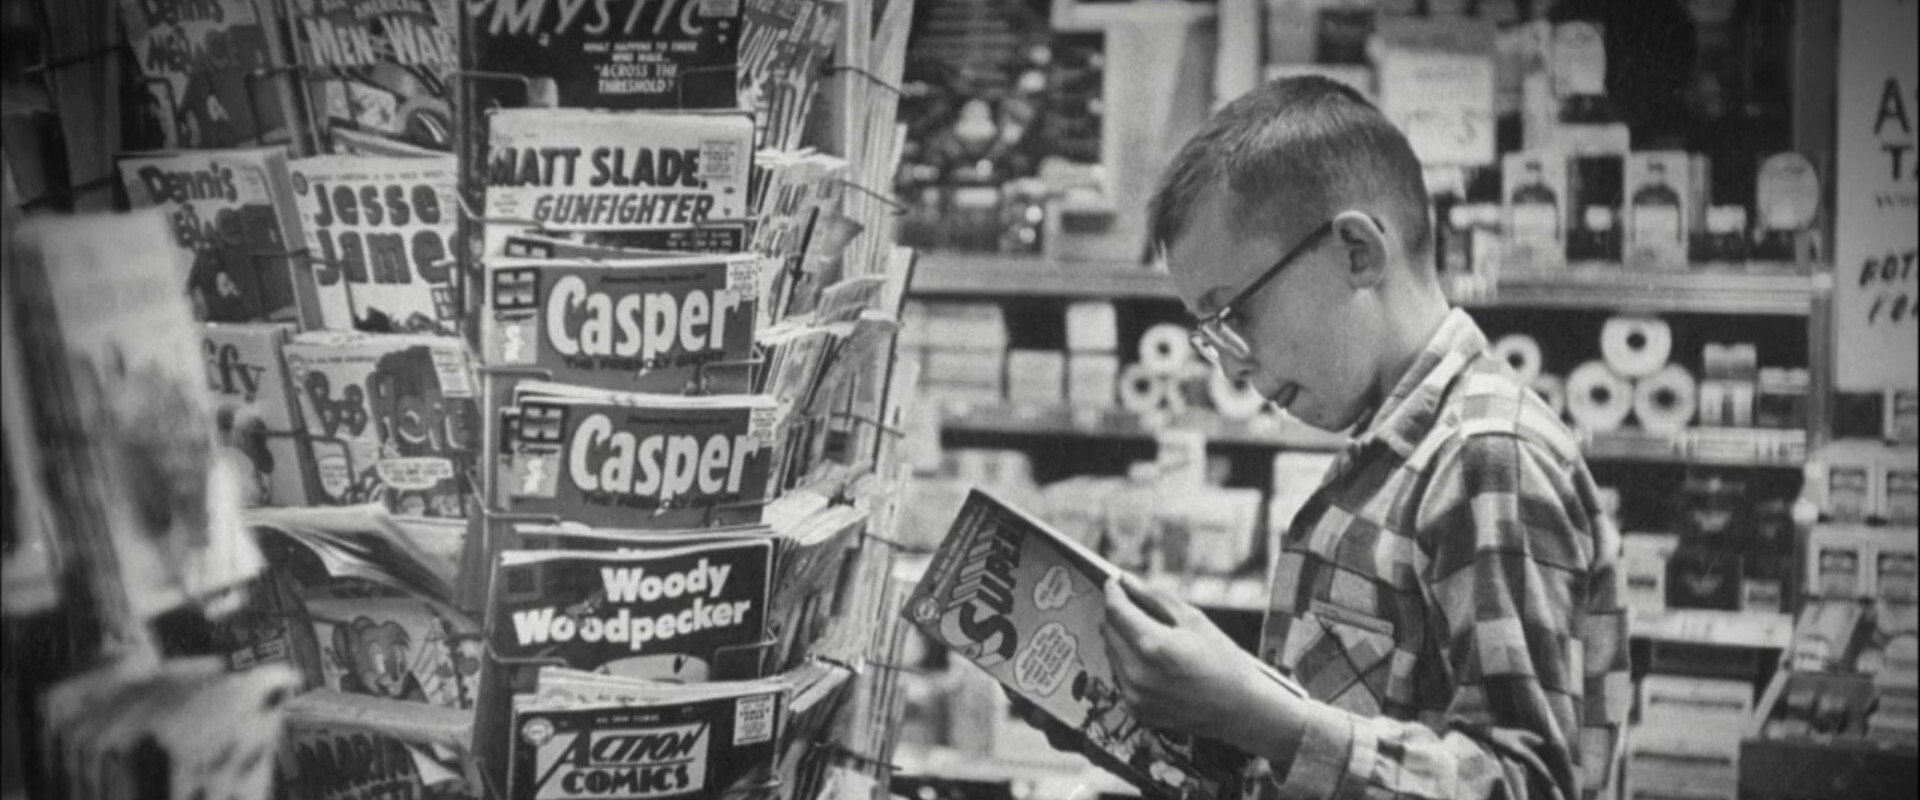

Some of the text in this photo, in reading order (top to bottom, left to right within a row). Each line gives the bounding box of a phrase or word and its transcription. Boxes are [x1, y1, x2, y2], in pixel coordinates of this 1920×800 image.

[303, 17, 375, 66] MEN
[656, 64, 678, 77] THE
[138, 162, 238, 204] Dennis
[489, 147, 581, 188] MATT
[313, 183, 441, 228] Jesse
[533, 194, 715, 226] GUNFIGHTER
[547, 275, 741, 364] Casper
[569, 413, 760, 501] Casper
[601, 558, 731, 602] Woody
[513, 599, 750, 650] Woodpecker
[536, 723, 707, 786] ACTION
[561, 765, 690, 795] COMICS
